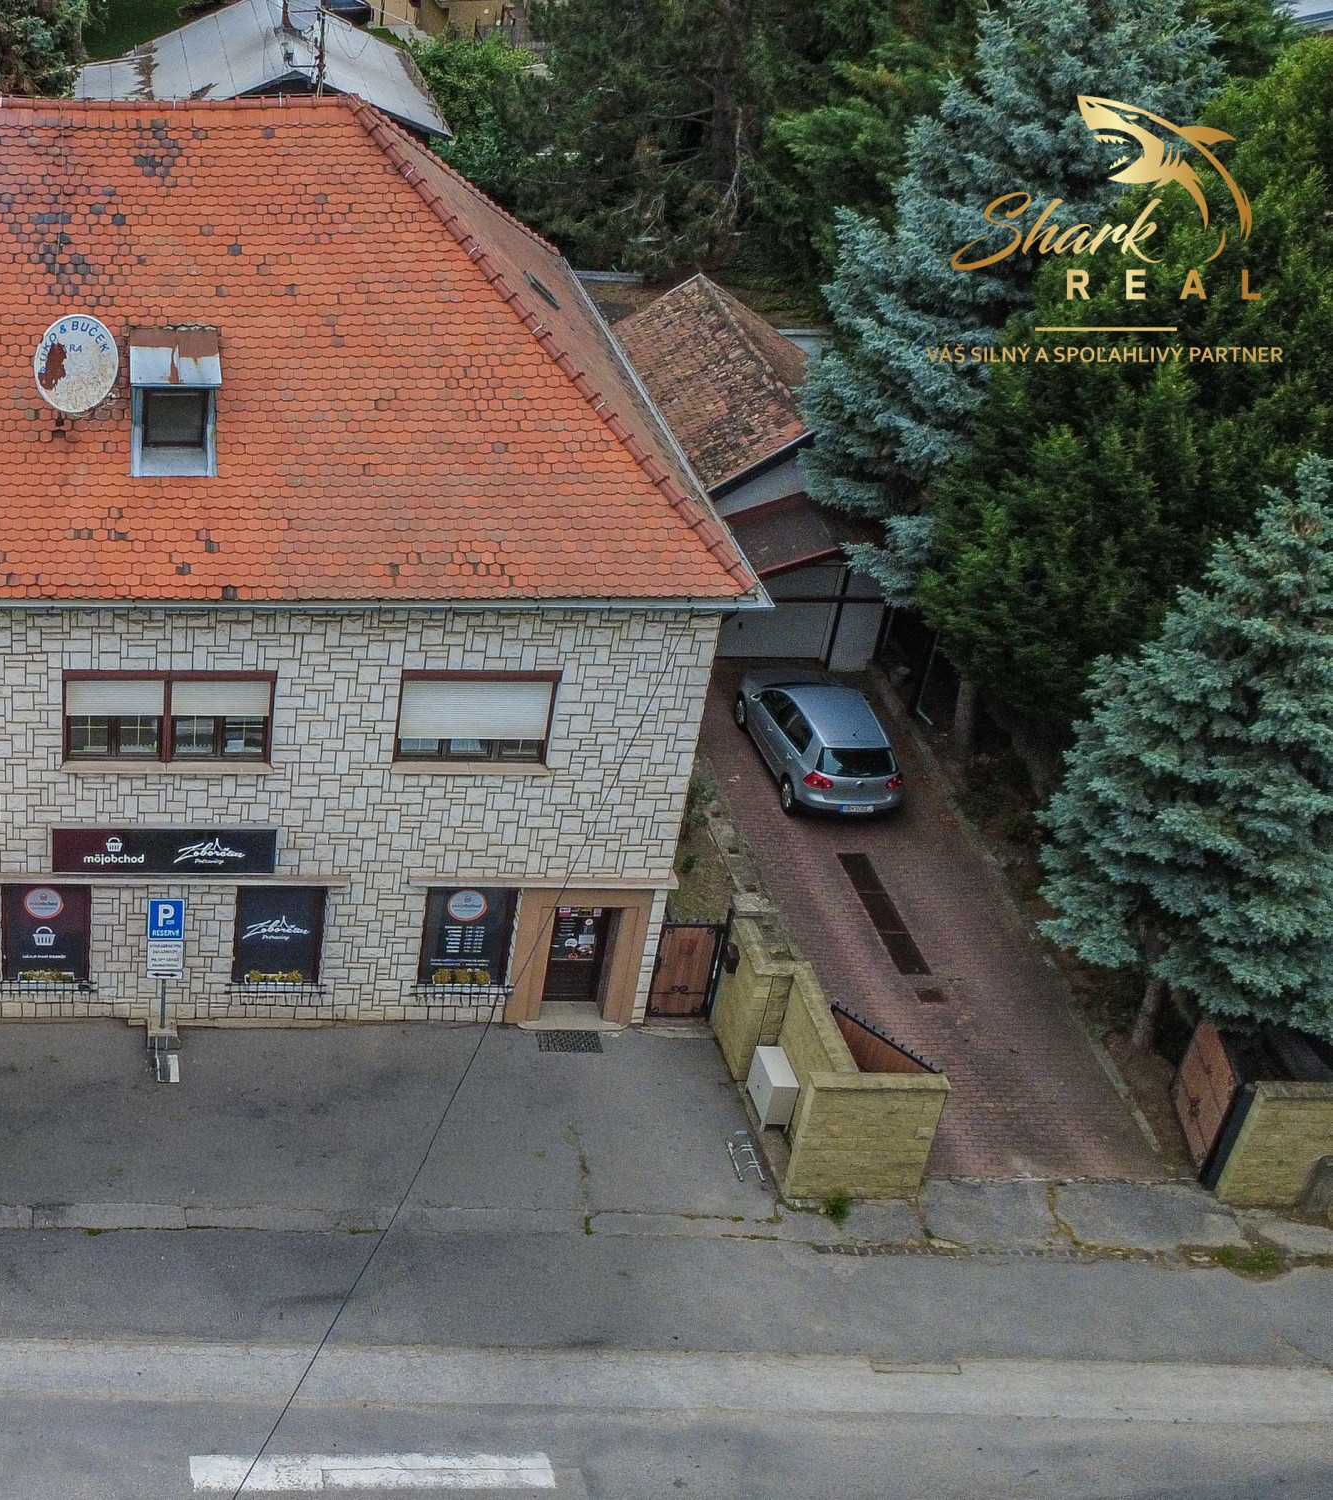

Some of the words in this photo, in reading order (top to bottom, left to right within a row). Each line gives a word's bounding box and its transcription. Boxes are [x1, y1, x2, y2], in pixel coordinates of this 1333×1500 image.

[71, 320, 110, 353] BUČEK
[83, 853, 145, 865] môjobchod
[158, 904, 175, 927] P
